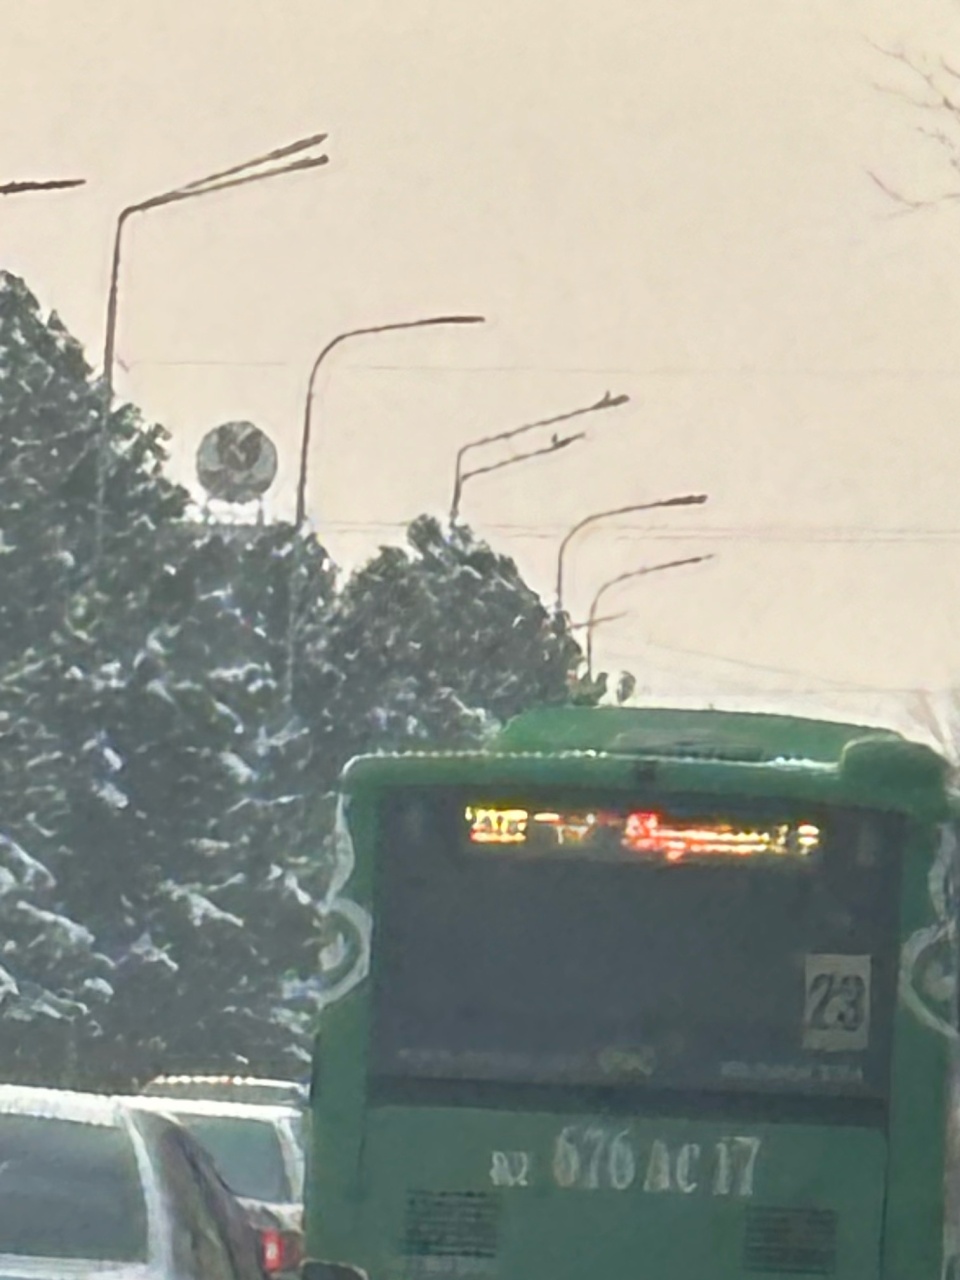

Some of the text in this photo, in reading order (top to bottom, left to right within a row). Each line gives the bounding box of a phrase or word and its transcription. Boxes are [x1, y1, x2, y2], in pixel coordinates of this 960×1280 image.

[808, 972, 867, 1033] 23
[553, 1125, 636, 1190] 676
[643, 1138, 701, 1194] AC
[712, 1136, 761, 1196] 17
